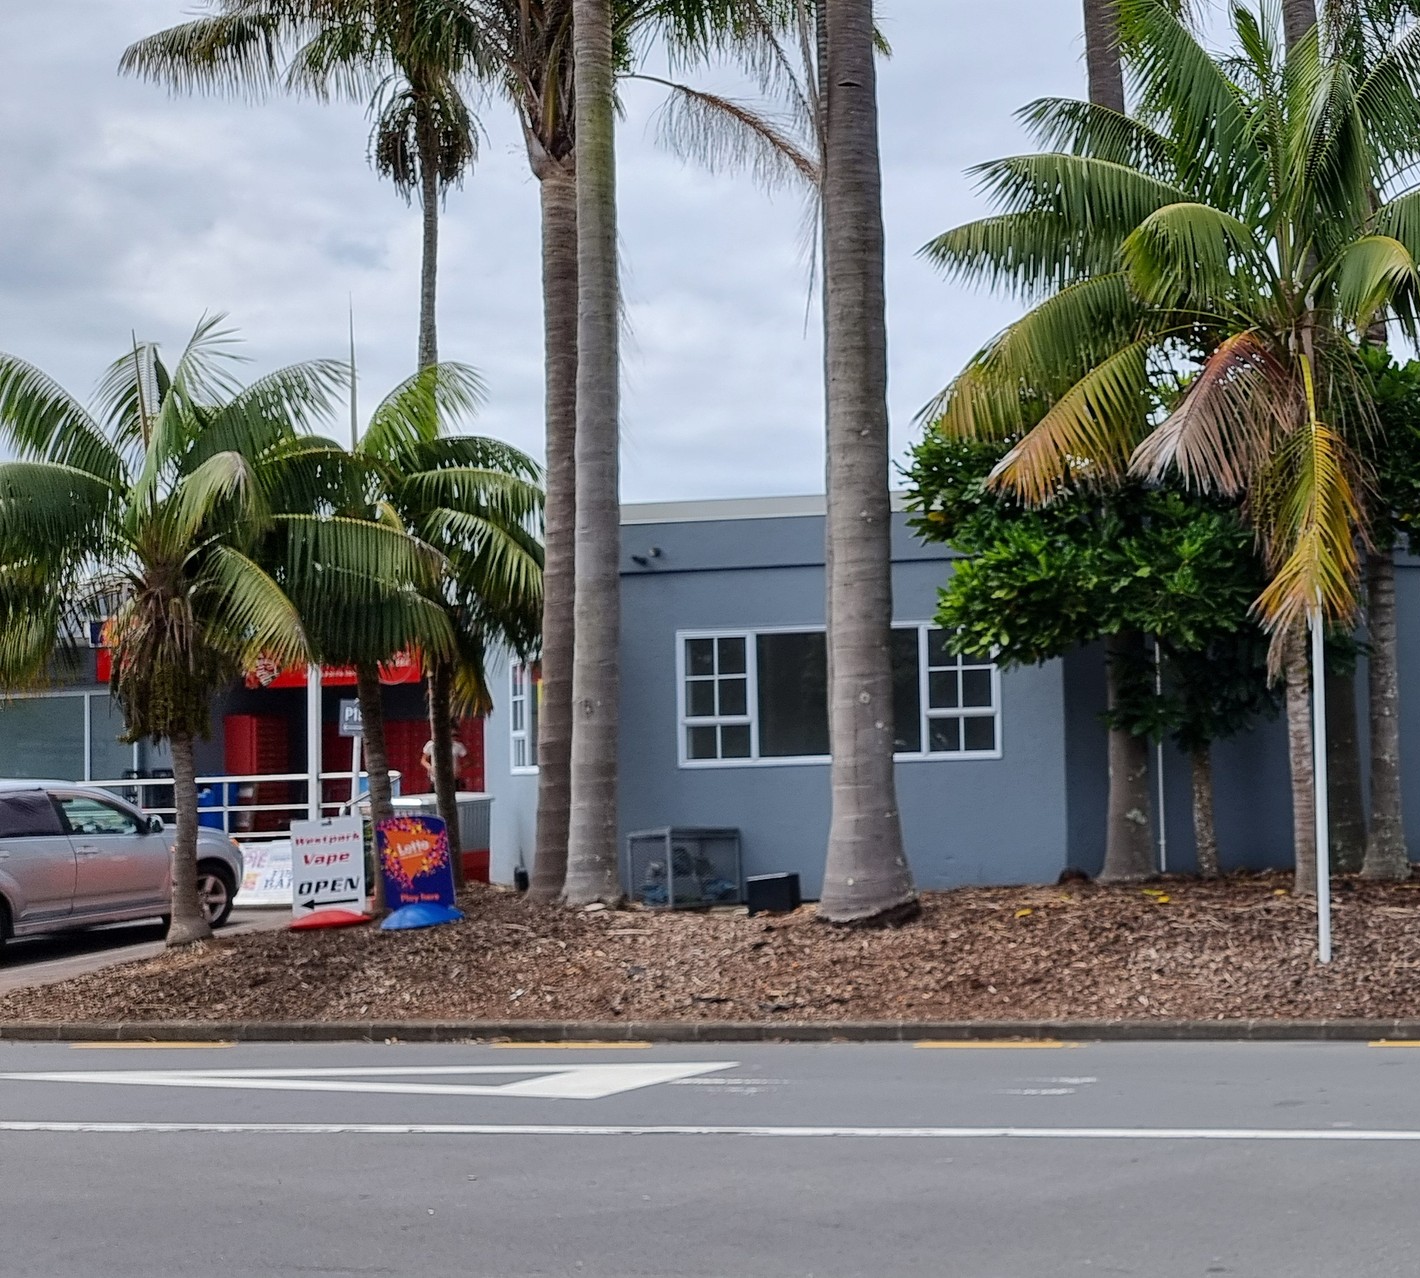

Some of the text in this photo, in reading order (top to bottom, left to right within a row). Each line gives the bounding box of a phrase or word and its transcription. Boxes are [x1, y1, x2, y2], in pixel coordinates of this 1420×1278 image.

[295, 831, 360, 847] Westpark
[397, 840, 429, 856] Lotto
[303, 852, 350, 867] Vape
[298, 876, 360, 895] OPEN
[400, 893, 439, 903] Play here
